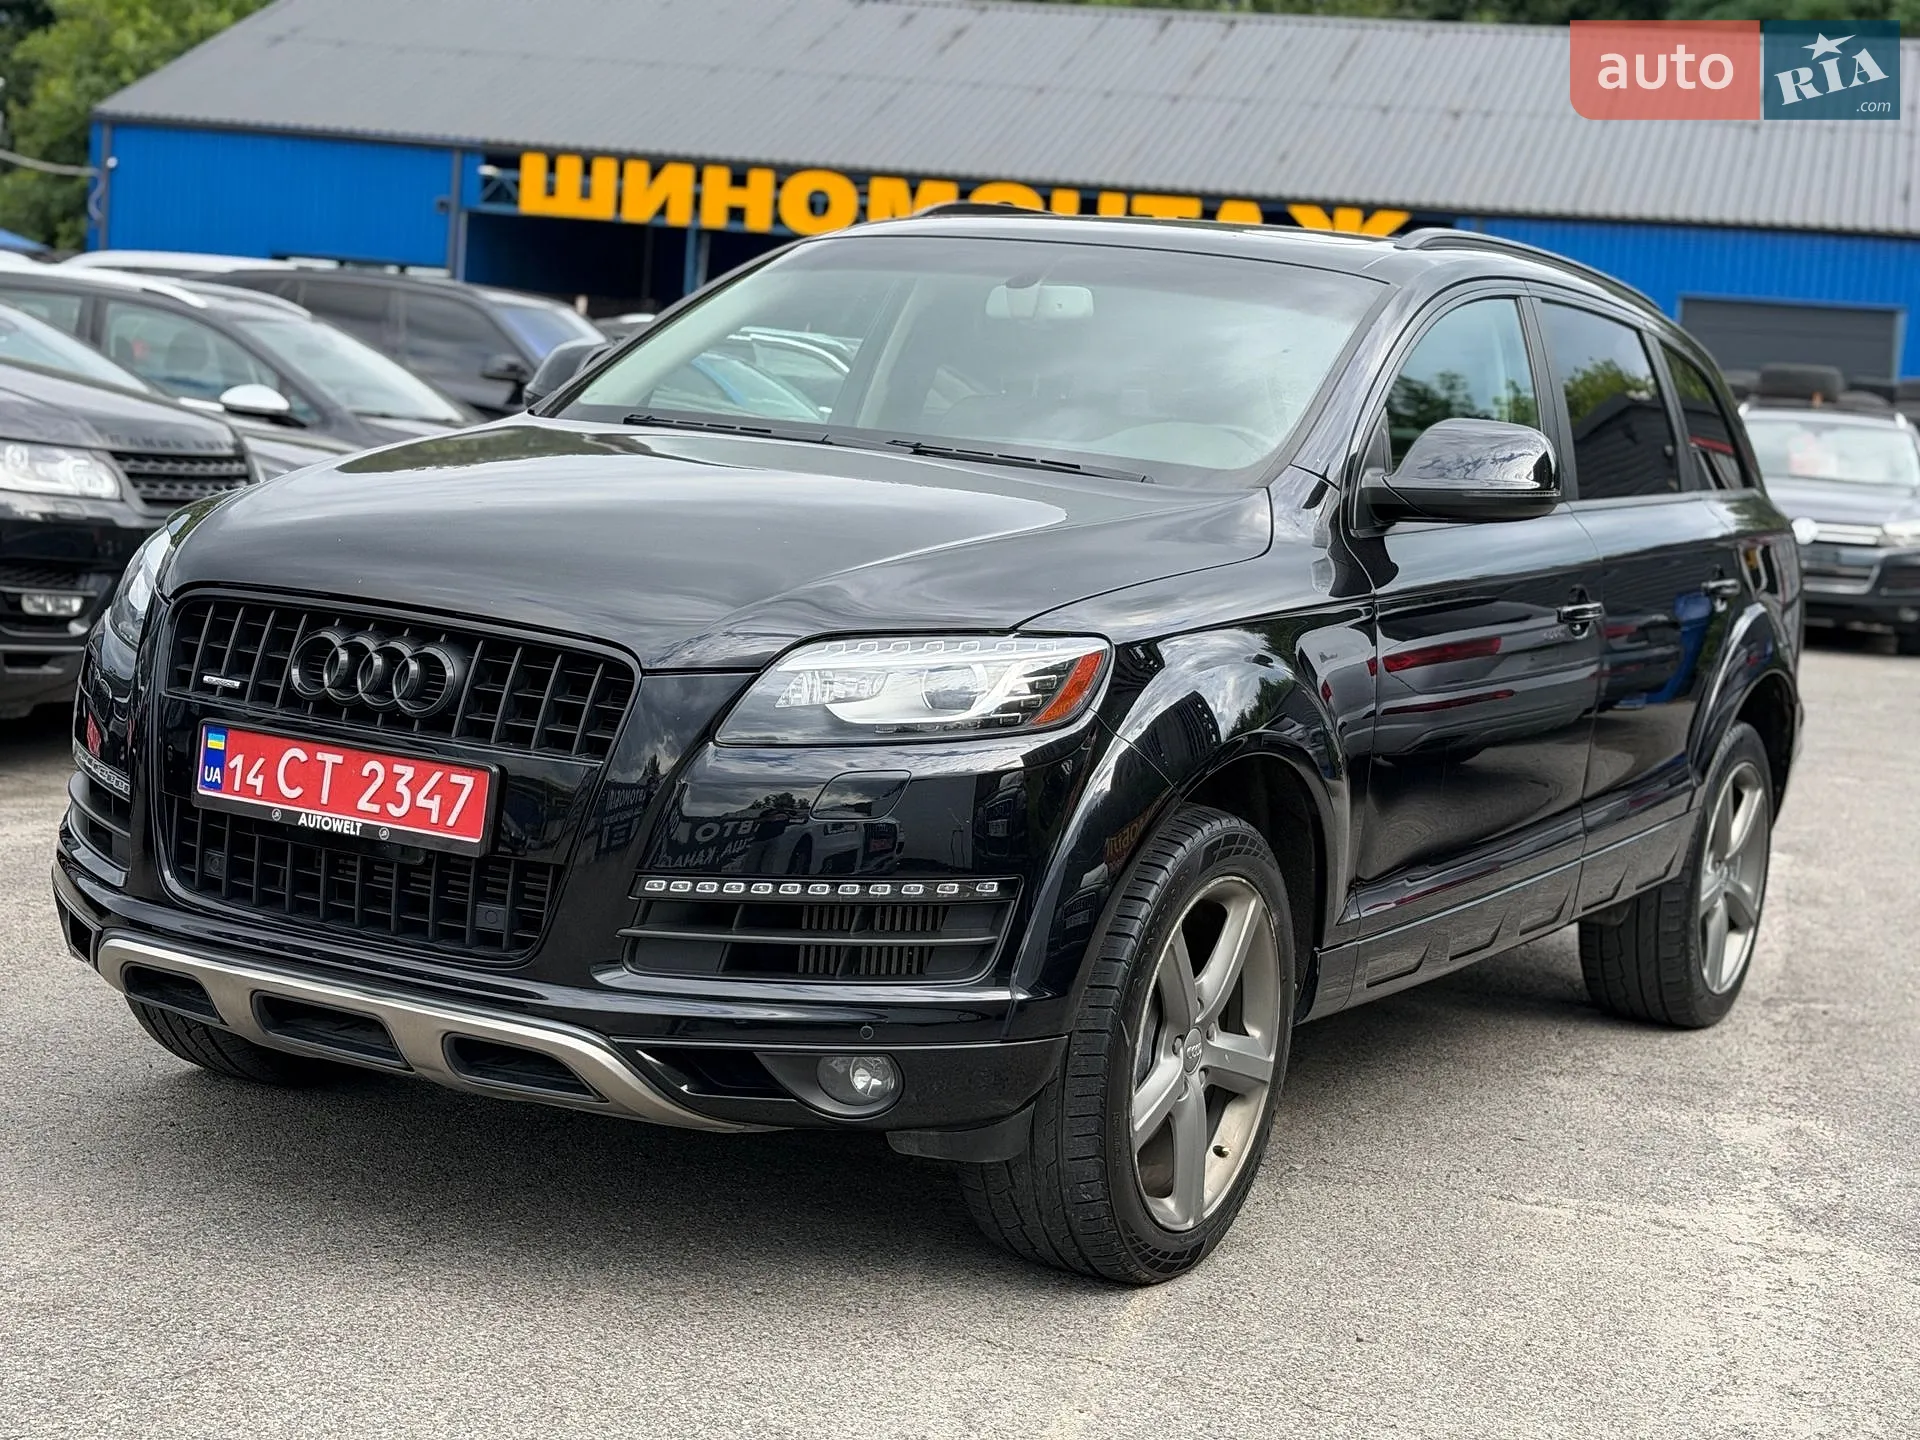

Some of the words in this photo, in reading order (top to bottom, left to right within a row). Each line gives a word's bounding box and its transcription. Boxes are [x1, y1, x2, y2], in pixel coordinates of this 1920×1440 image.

[204, 766, 222, 784] UA
[228, 753, 266, 797] 14
[357, 760, 474, 827] 2347
[298, 812, 362, 836] AUTOWELT
